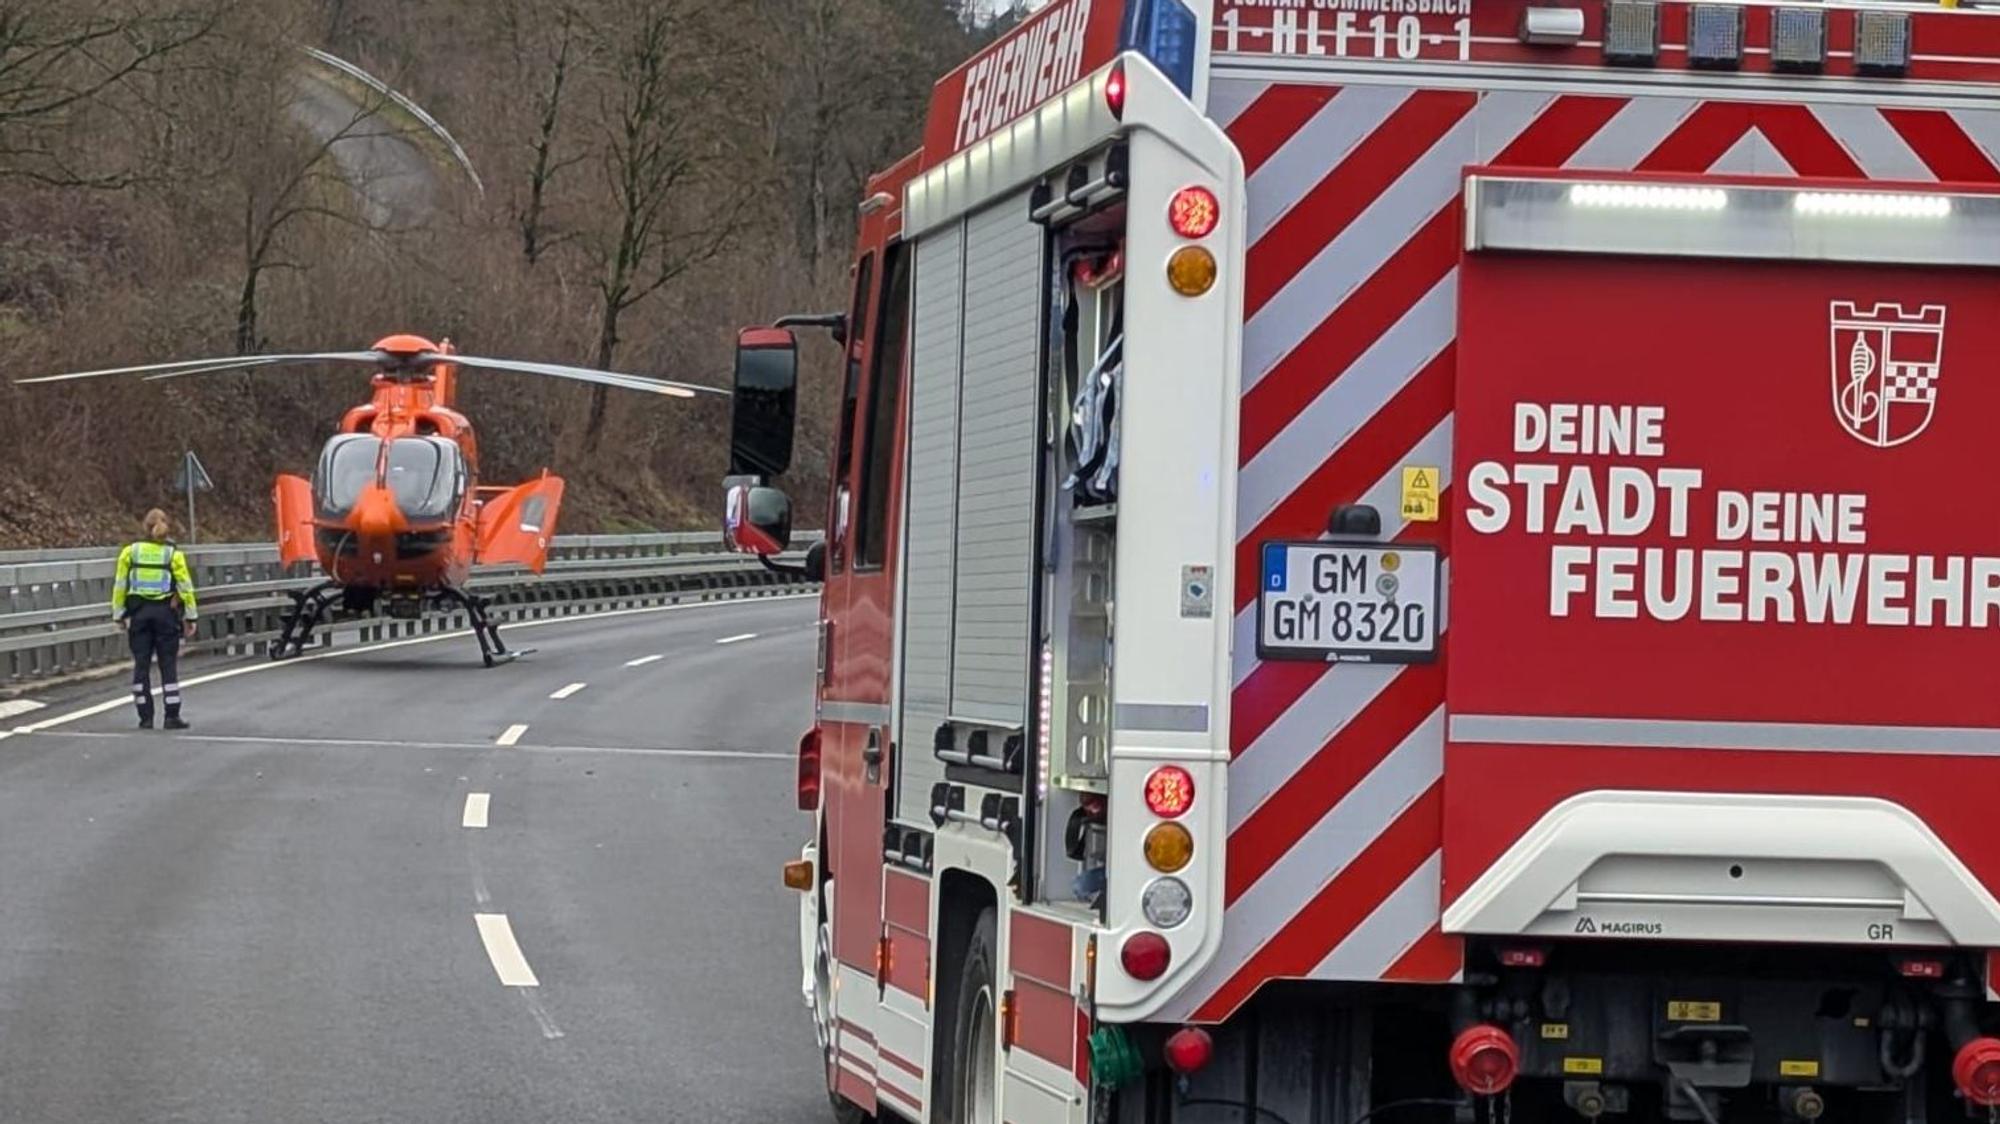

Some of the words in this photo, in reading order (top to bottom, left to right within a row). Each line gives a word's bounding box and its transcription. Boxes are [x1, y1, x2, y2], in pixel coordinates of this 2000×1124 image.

[954, 0, 1091, 152] FEUERWEHR
[1513, 402, 1665, 456] DEINE
[1466, 461, 1703, 537] STADT
[1716, 490, 1867, 544] DEINE
[1271, 574, 1282, 587] D
[1312, 553, 1368, 594] GM
[1549, 545, 2000, 628] FEUERWEHR
[1274, 600, 1321, 641] GM
[1331, 601, 1425, 643] 8320
[1601, 922, 1663, 934] MAGIRUS
[1867, 923, 1894, 940] GR
